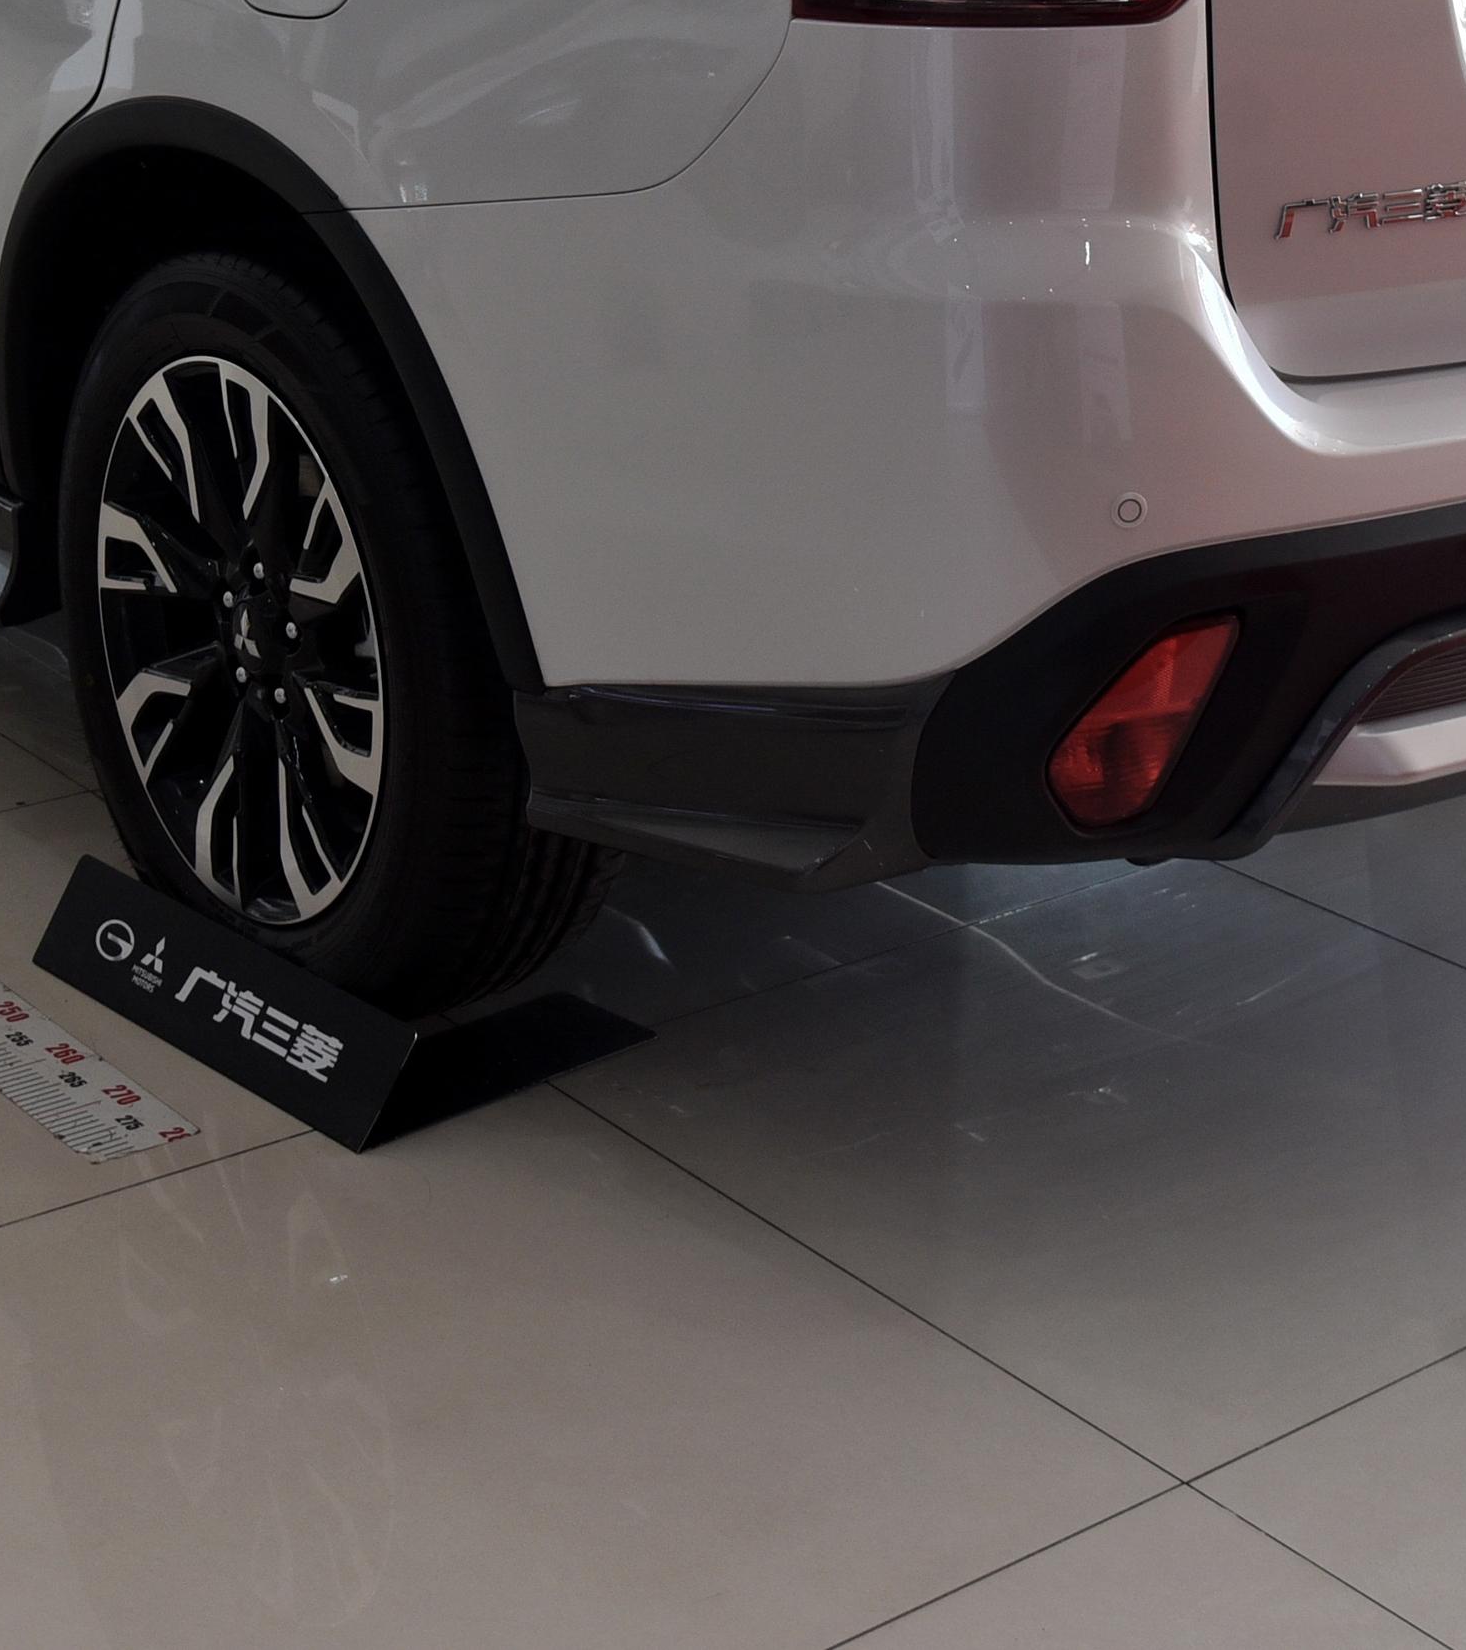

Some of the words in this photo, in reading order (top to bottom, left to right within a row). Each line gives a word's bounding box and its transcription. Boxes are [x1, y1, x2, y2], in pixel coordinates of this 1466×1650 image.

[131, 963, 163, 988] MITSUBISHI
[131, 974, 155, 994] MOTORS
[174, 966, 344, 1083] 广汽三菱
[5, 1031, 33, 1047] 255
[45, 1042, 86, 1066] 260
[58, 1071, 88, 1089] 265
[101, 1084, 142, 1107] 270
[115, 1114, 144, 1131] 275
